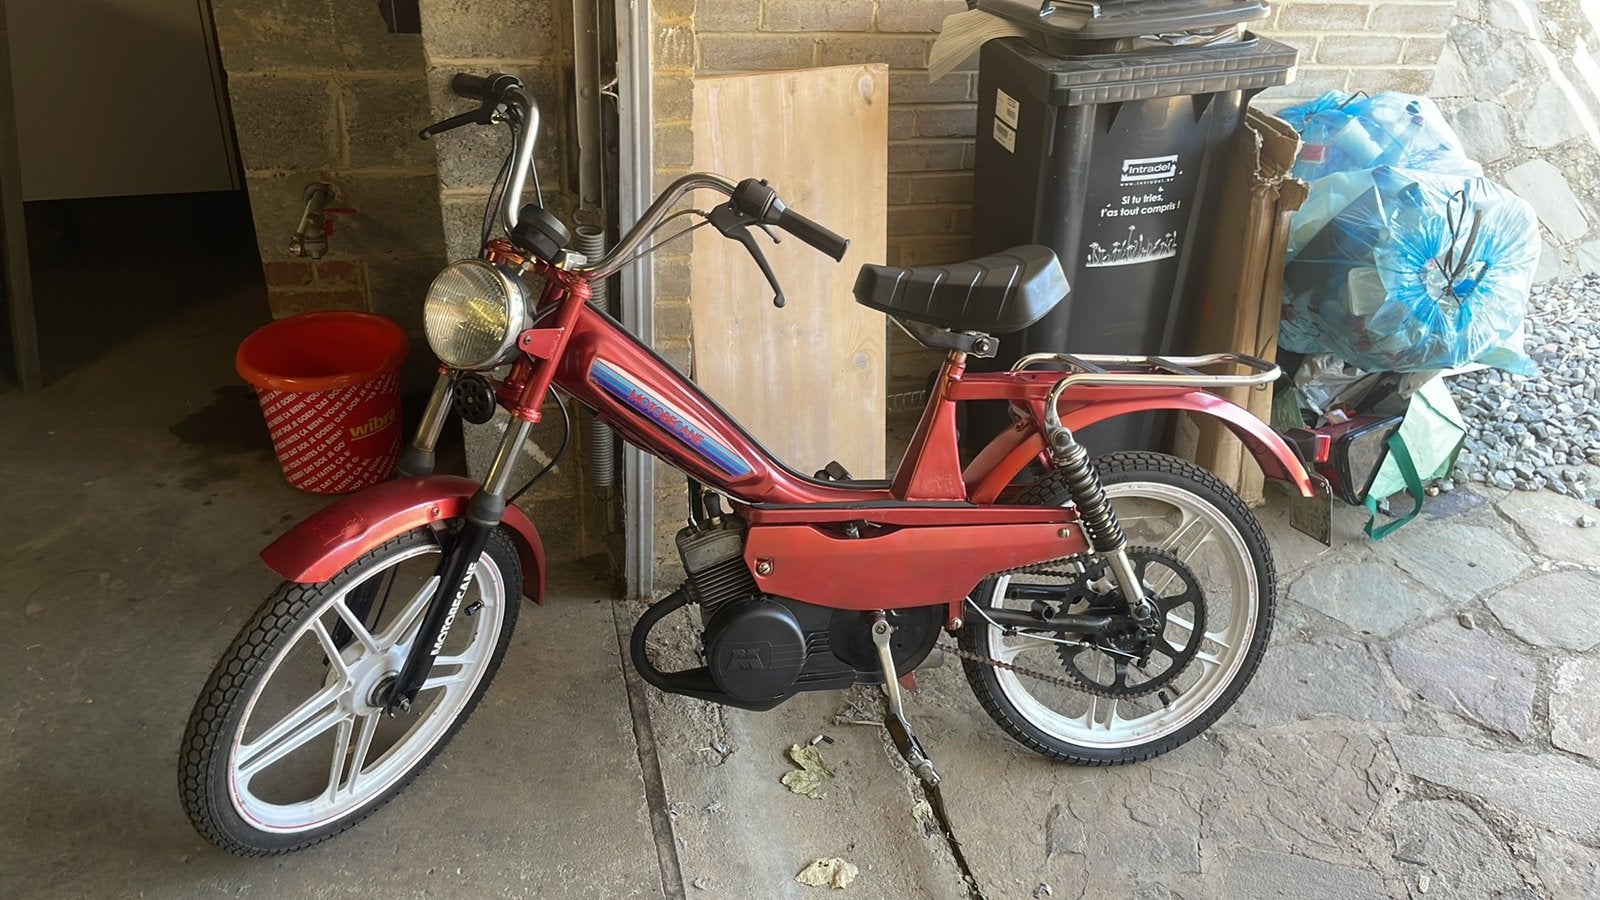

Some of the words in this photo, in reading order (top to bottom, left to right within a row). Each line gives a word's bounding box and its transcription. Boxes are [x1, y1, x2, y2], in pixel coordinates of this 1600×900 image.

[1129, 163, 1171, 174] Intradel
[1121, 196, 1130, 205] Si
[1132, 196, 1141, 204] tu
[1100, 208, 1118, 217] t'as
[1120, 207, 1139, 216] tout
[1141, 202, 1176, 214] compris
[322, 401, 343, 418] VOUS
[627, 389, 704, 446] MOTOBECANE
[349, 409, 396, 437] wibra
